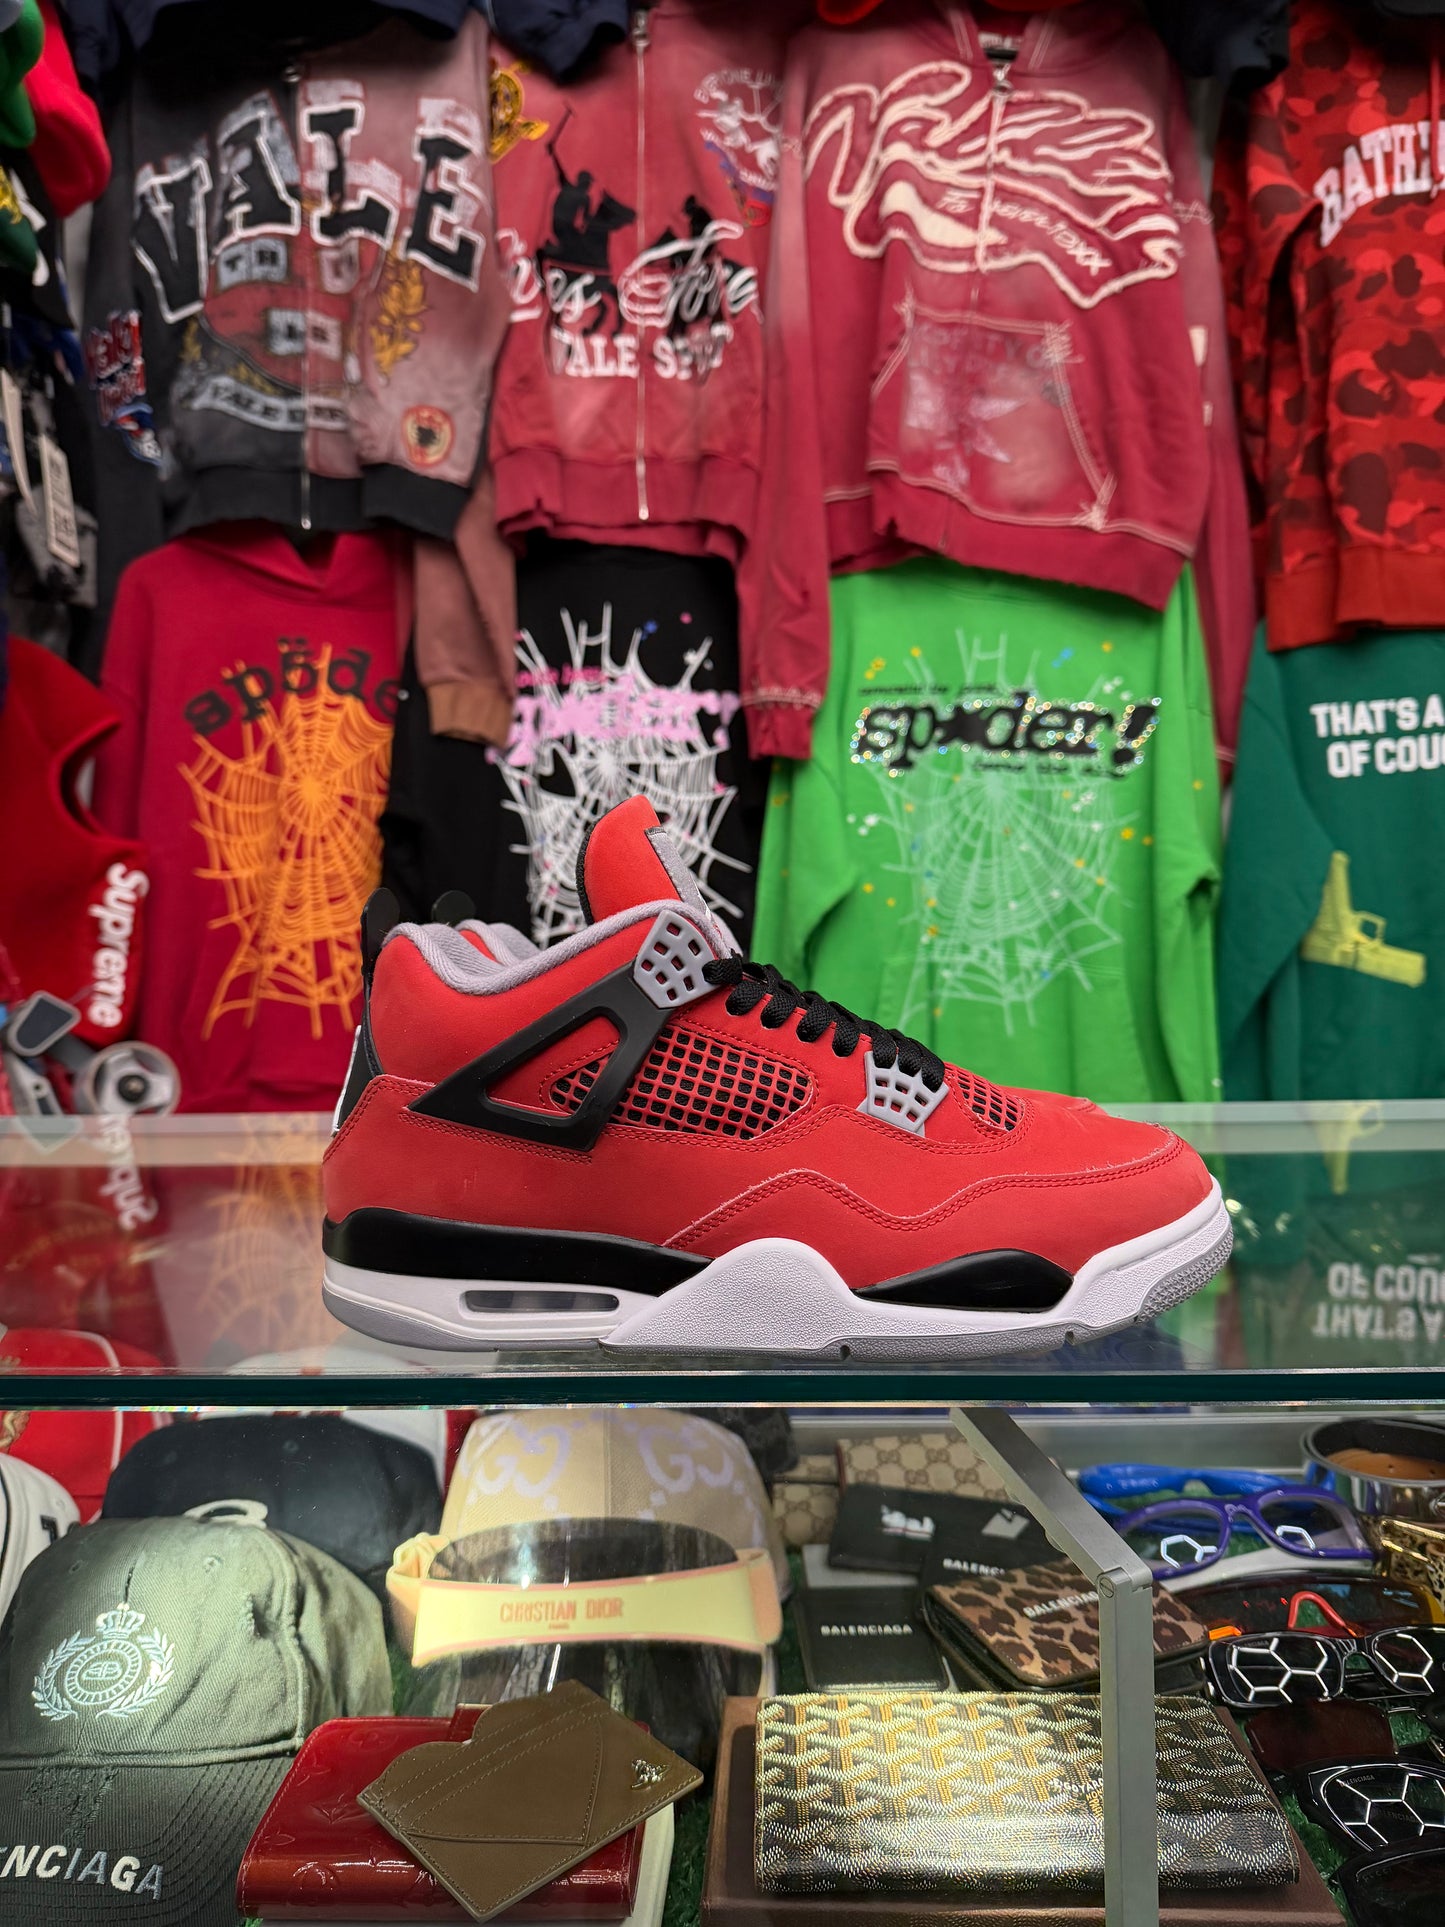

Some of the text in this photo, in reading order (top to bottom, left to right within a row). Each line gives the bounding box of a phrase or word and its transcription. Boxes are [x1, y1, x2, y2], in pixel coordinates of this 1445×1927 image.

[1309, 693, 1445, 738] THAT'S A
[1326, 732, 1445, 778] OF COU
[89, 863, 150, 1028] Supreme
[500, 1597, 623, 1622] CHRISTIAN DIOR
[821, 1624, 913, 1636] BALENCIAGA
[0, 1845, 164, 1900] NCIAGA
